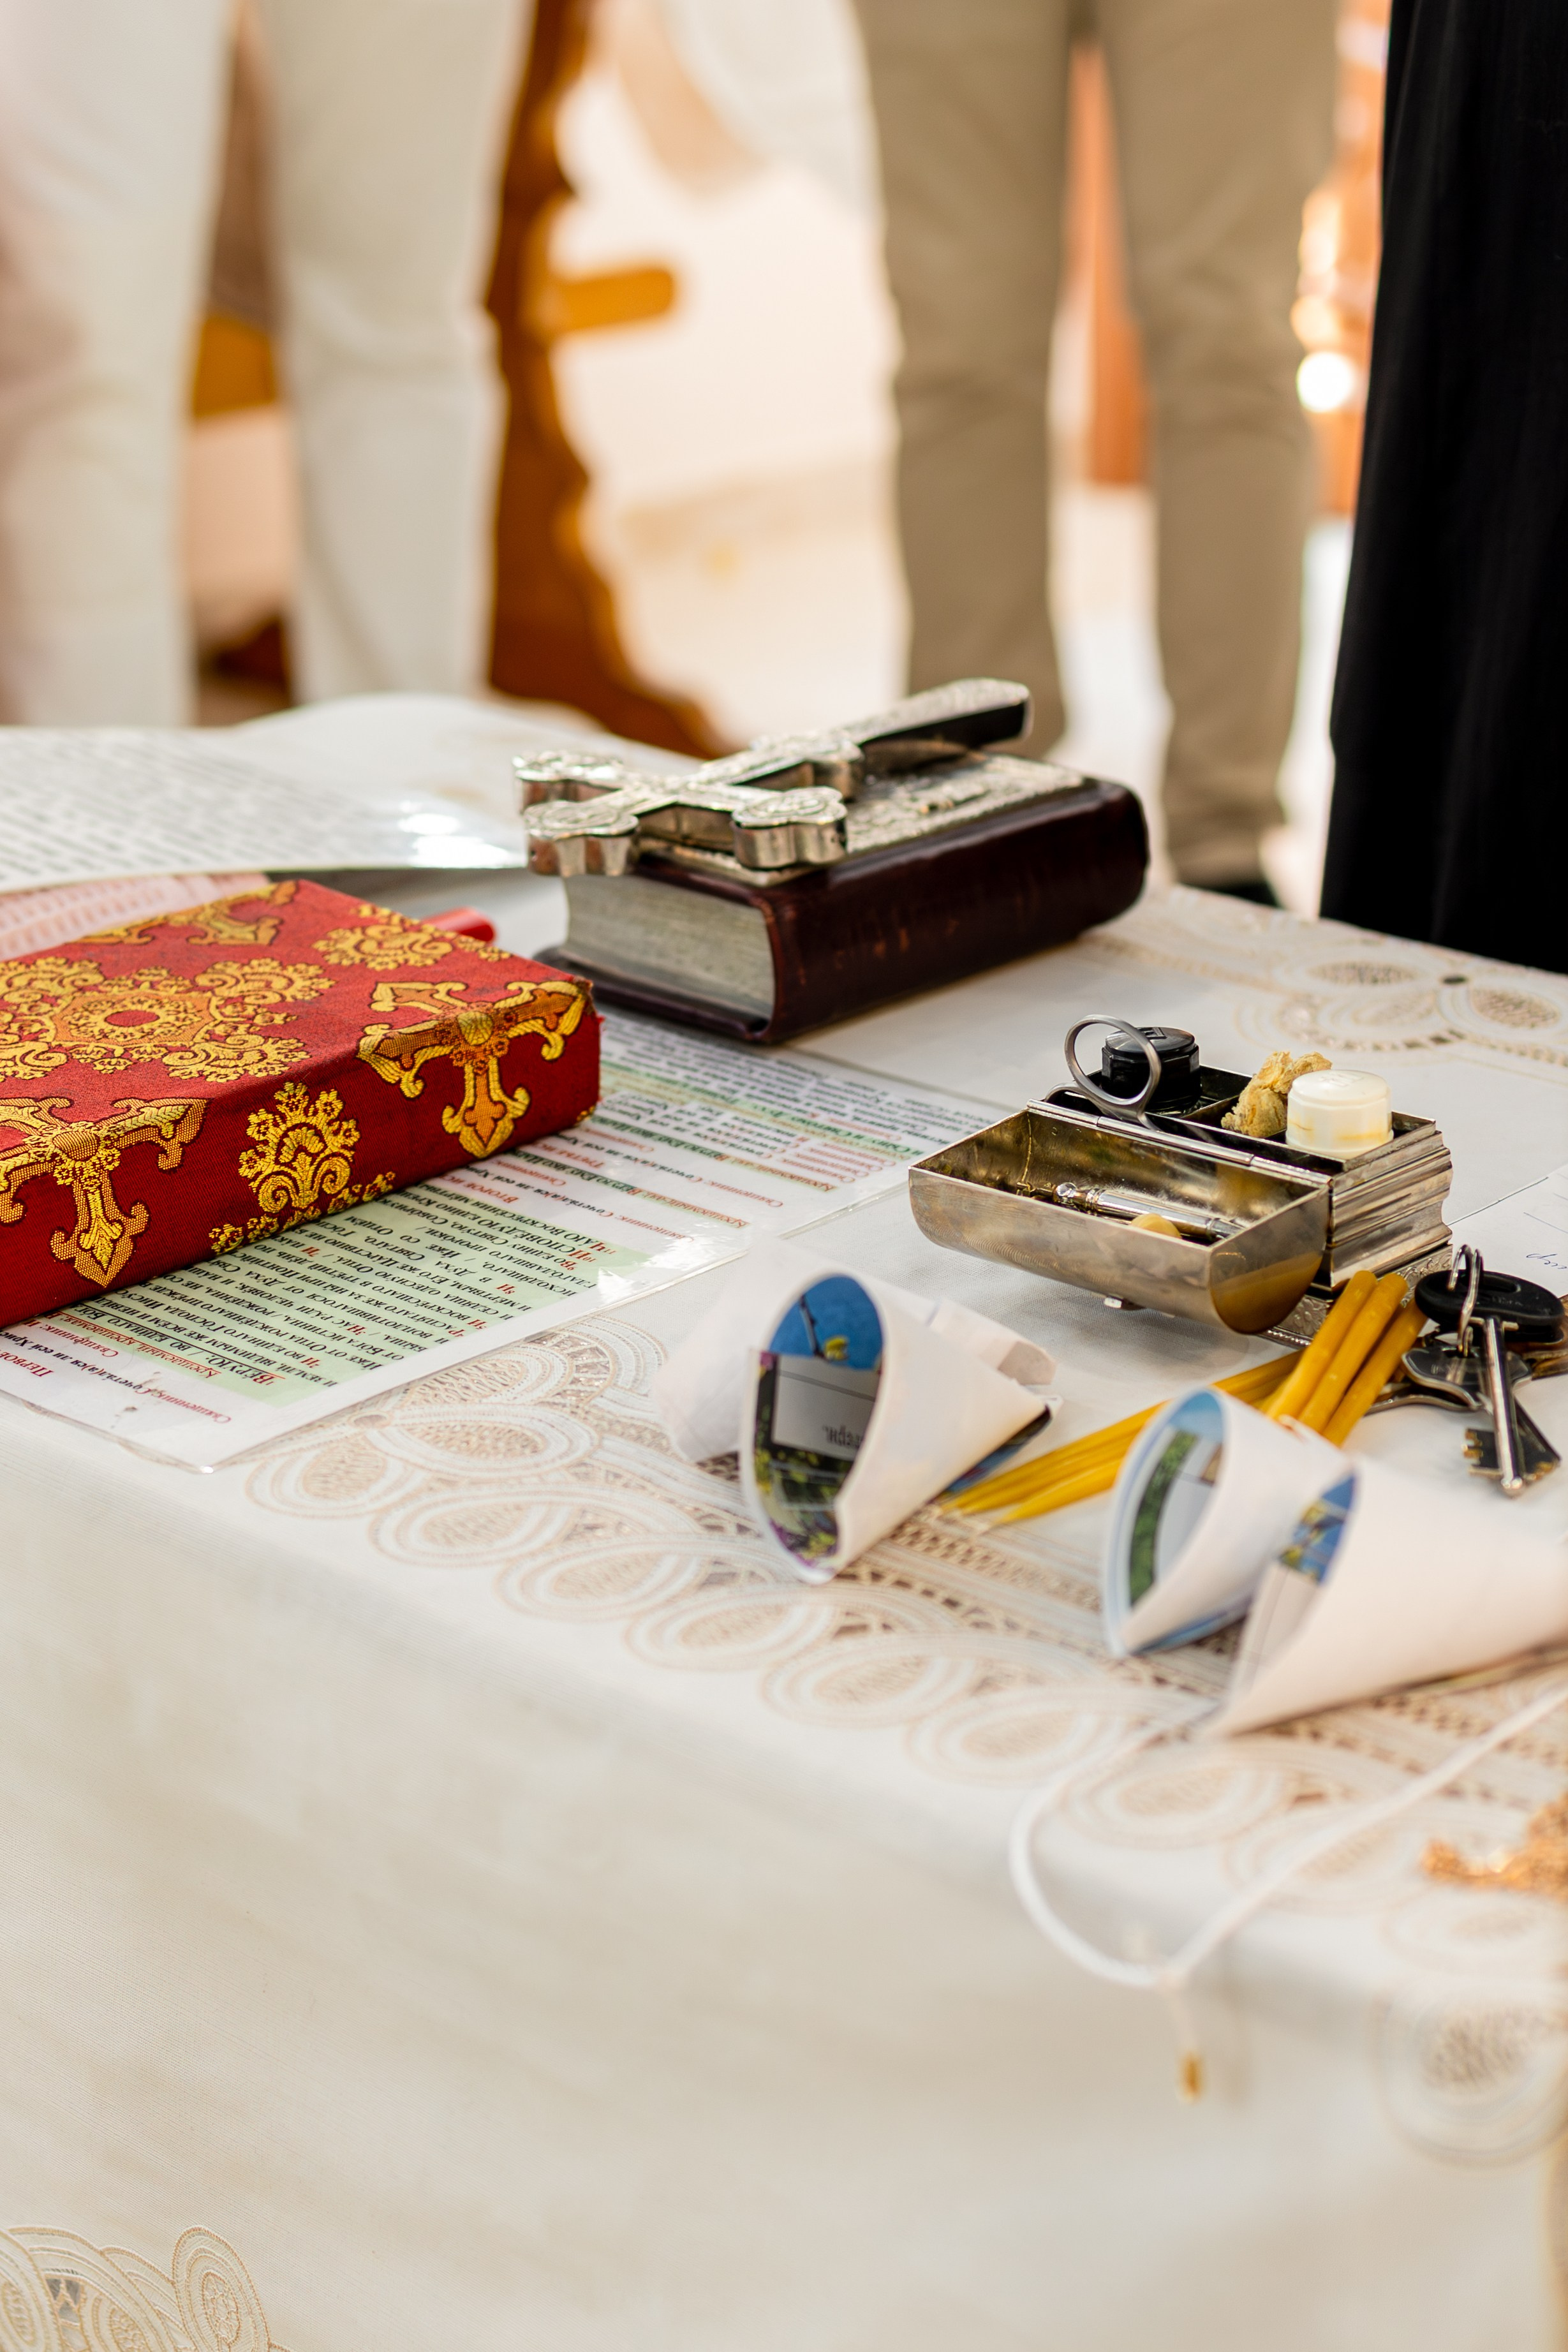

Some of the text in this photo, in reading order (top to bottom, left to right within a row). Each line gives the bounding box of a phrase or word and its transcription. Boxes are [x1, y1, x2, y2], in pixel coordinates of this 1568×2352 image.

[396, 1262, 421, 1274] ЖЕ
[180, 1280, 204, 1290] НЕ
[281, 1285, 305, 1294] ОТ
[347, 1291, 366, 1300] ЗА
[361, 1297, 387, 1308] ЖЕ
[182, 1329, 209, 1342] ЖЕ
[52, 1352, 73, 1361] ли
[283, 1350, 306, 1360] ВО
[324, 1348, 348, 1357] ОТ
[380, 1351, 404, 1361] ОТ
